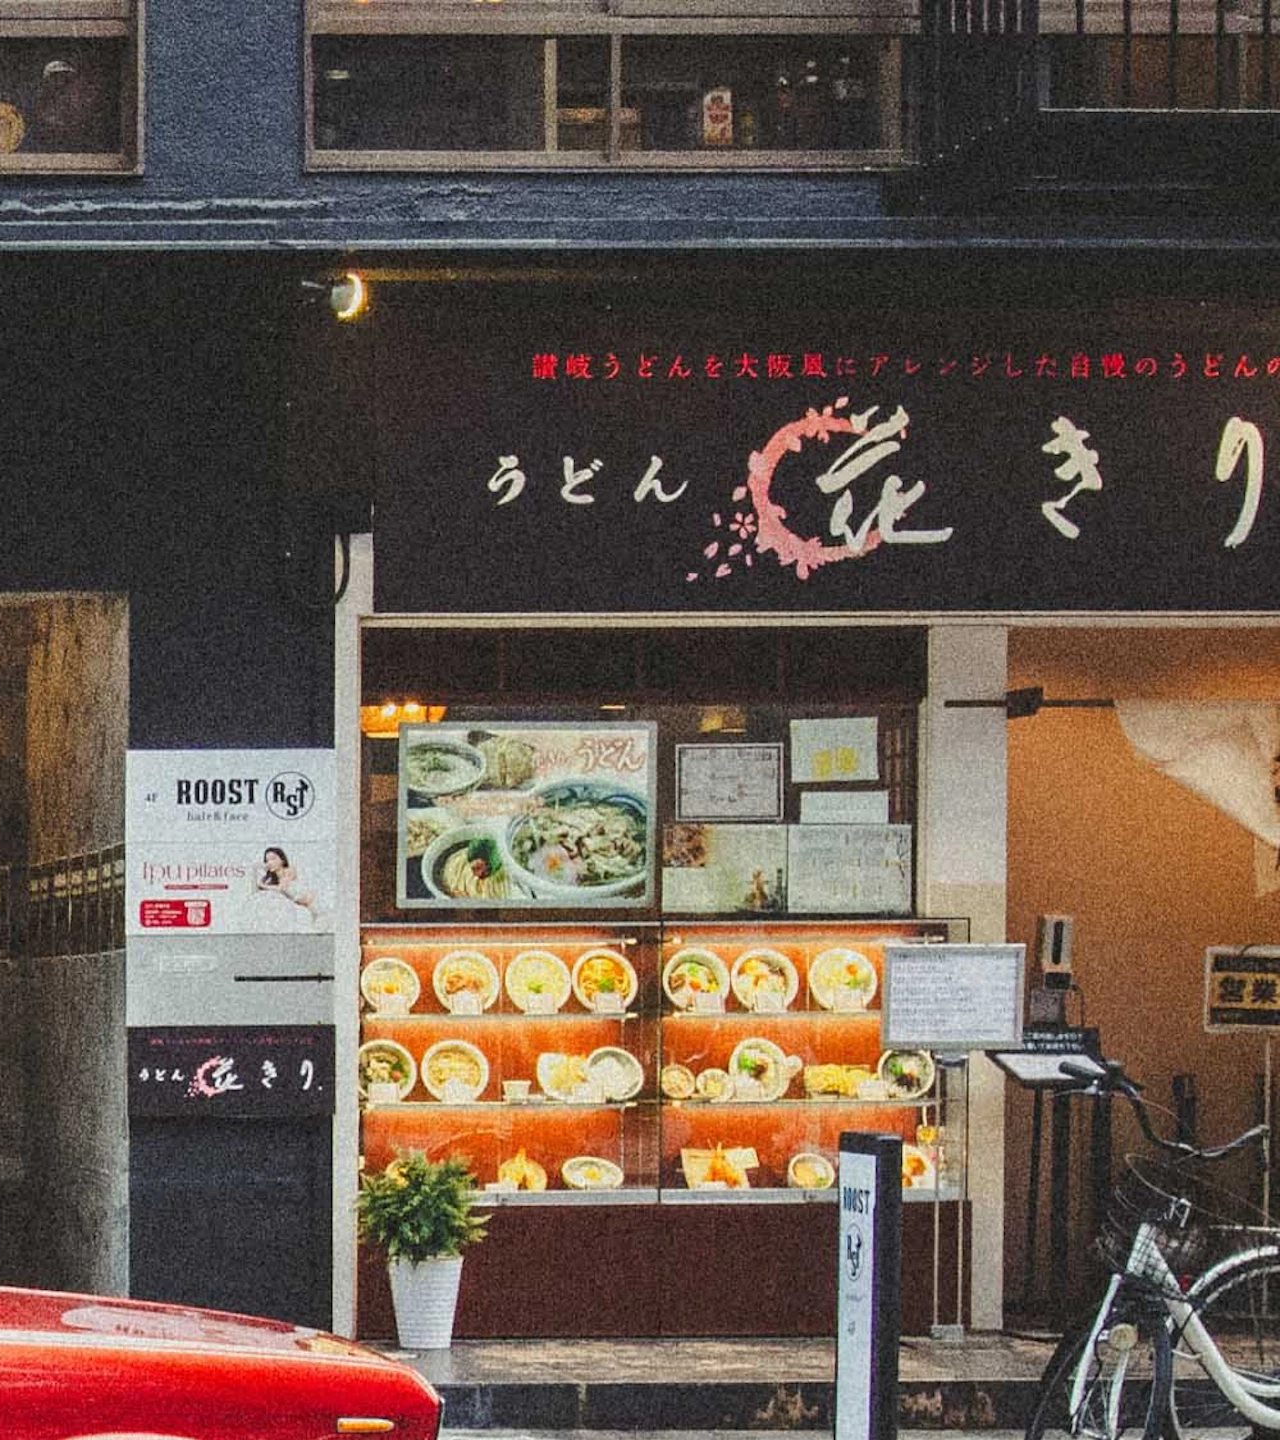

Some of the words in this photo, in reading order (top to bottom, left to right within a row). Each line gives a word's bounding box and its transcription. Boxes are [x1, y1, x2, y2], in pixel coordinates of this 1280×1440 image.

[488, 455, 689, 505] うどん
[177, 779, 260, 805] ROOST
